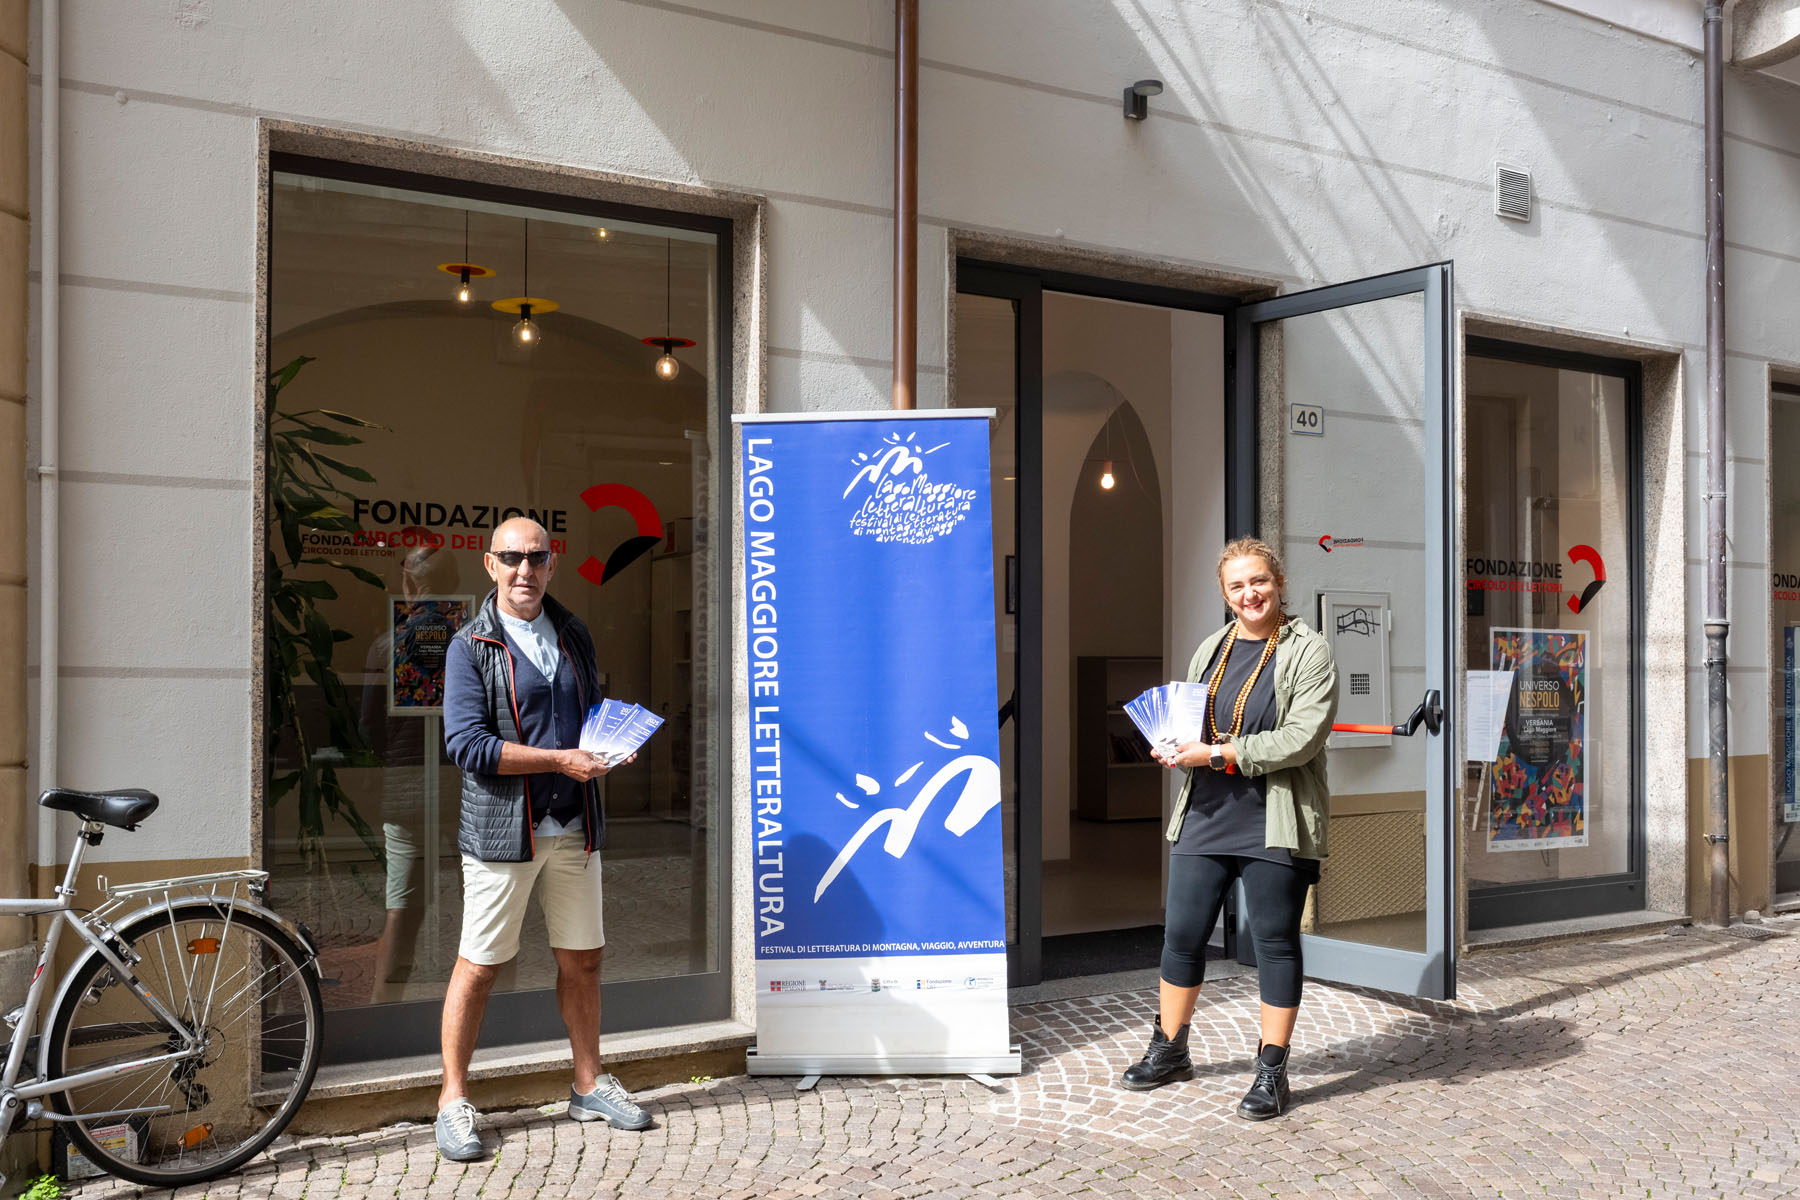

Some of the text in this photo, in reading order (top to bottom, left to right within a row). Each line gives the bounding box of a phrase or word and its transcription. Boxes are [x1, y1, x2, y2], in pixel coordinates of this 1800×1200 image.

[1297, 410, 1318, 427] 40
[875, 473, 976, 503] Lago Maggiore
[850, 510, 892, 528] festival
[854, 528, 863, 536] di
[876, 534, 934, 545] avventura
[353, 529, 445, 549] CIRCOLO
[451, 534, 483, 551] DEI
[302, 546, 396, 558] CIRCOLO DEI LETTORI
[1467, 558, 1562, 579] FONDAZIONE
[1467, 578, 1562, 593] CIRCOLO DEI LETTORI
[416, 631, 447, 640] NESPOLO
[748, 438, 785, 938] LAGO MAGGIORE LETTERALTURA
[1520, 680, 1560, 691] UNIVERSO
[1520, 691, 1560, 708] NESPOLO
[1535, 726, 1557, 734] Maggiore
[760, 940, 1005, 954] FESTIVAL DI LETTERATURA DI MONTAGNA, VIAGGIO, AVVENTURA
